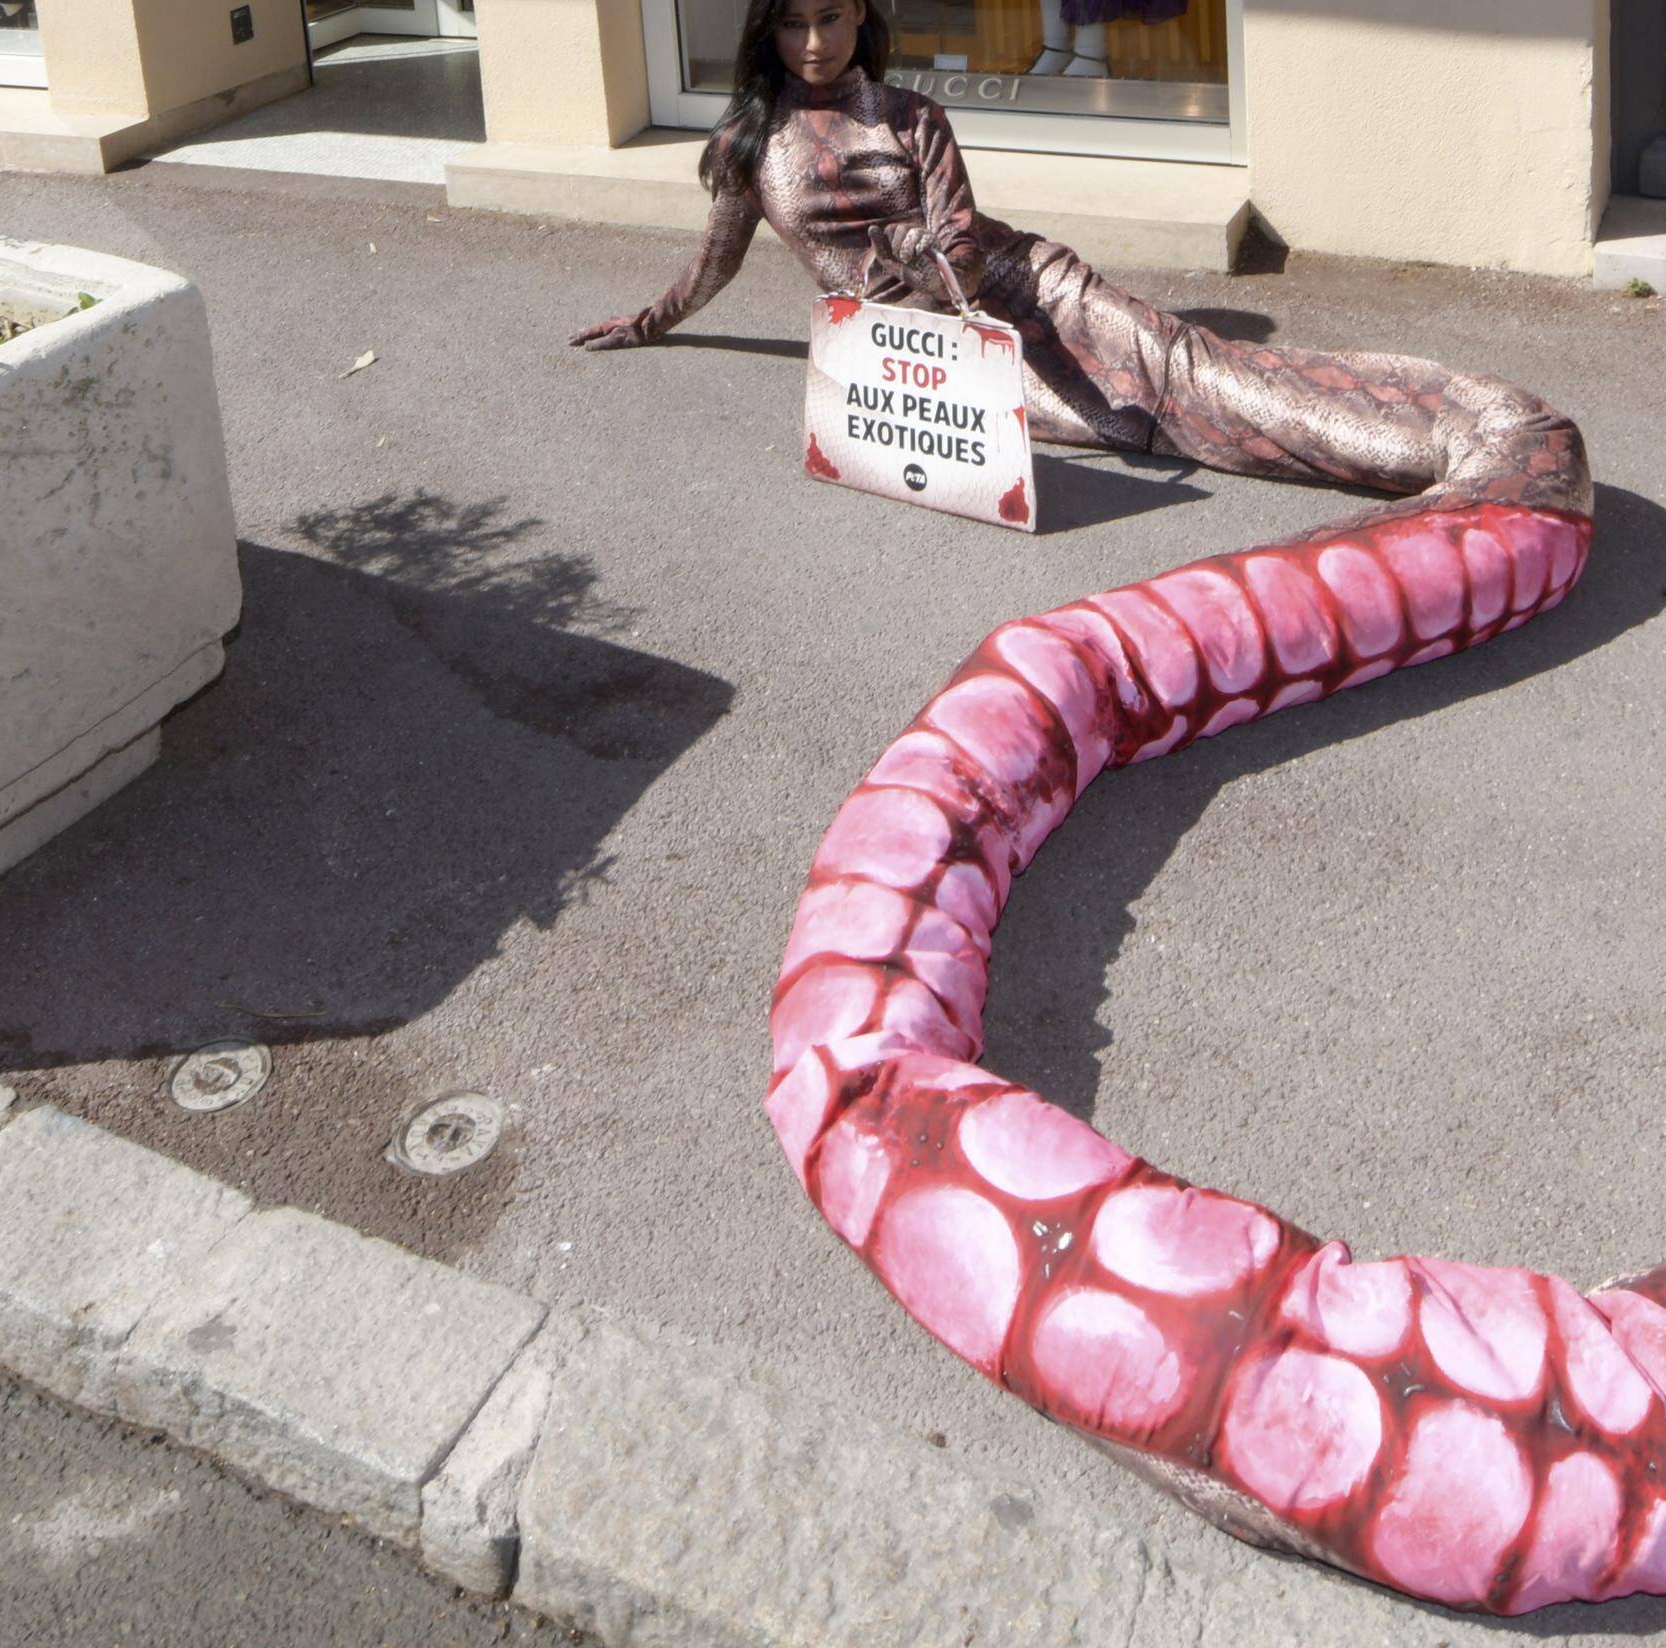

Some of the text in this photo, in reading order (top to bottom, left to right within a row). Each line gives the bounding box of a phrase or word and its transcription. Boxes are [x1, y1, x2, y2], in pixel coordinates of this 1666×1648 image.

[882, 356, 947, 391] STOP
[846, 382, 986, 434] AUX PEAUX
[847, 414, 986, 467] EXOTIQUES
